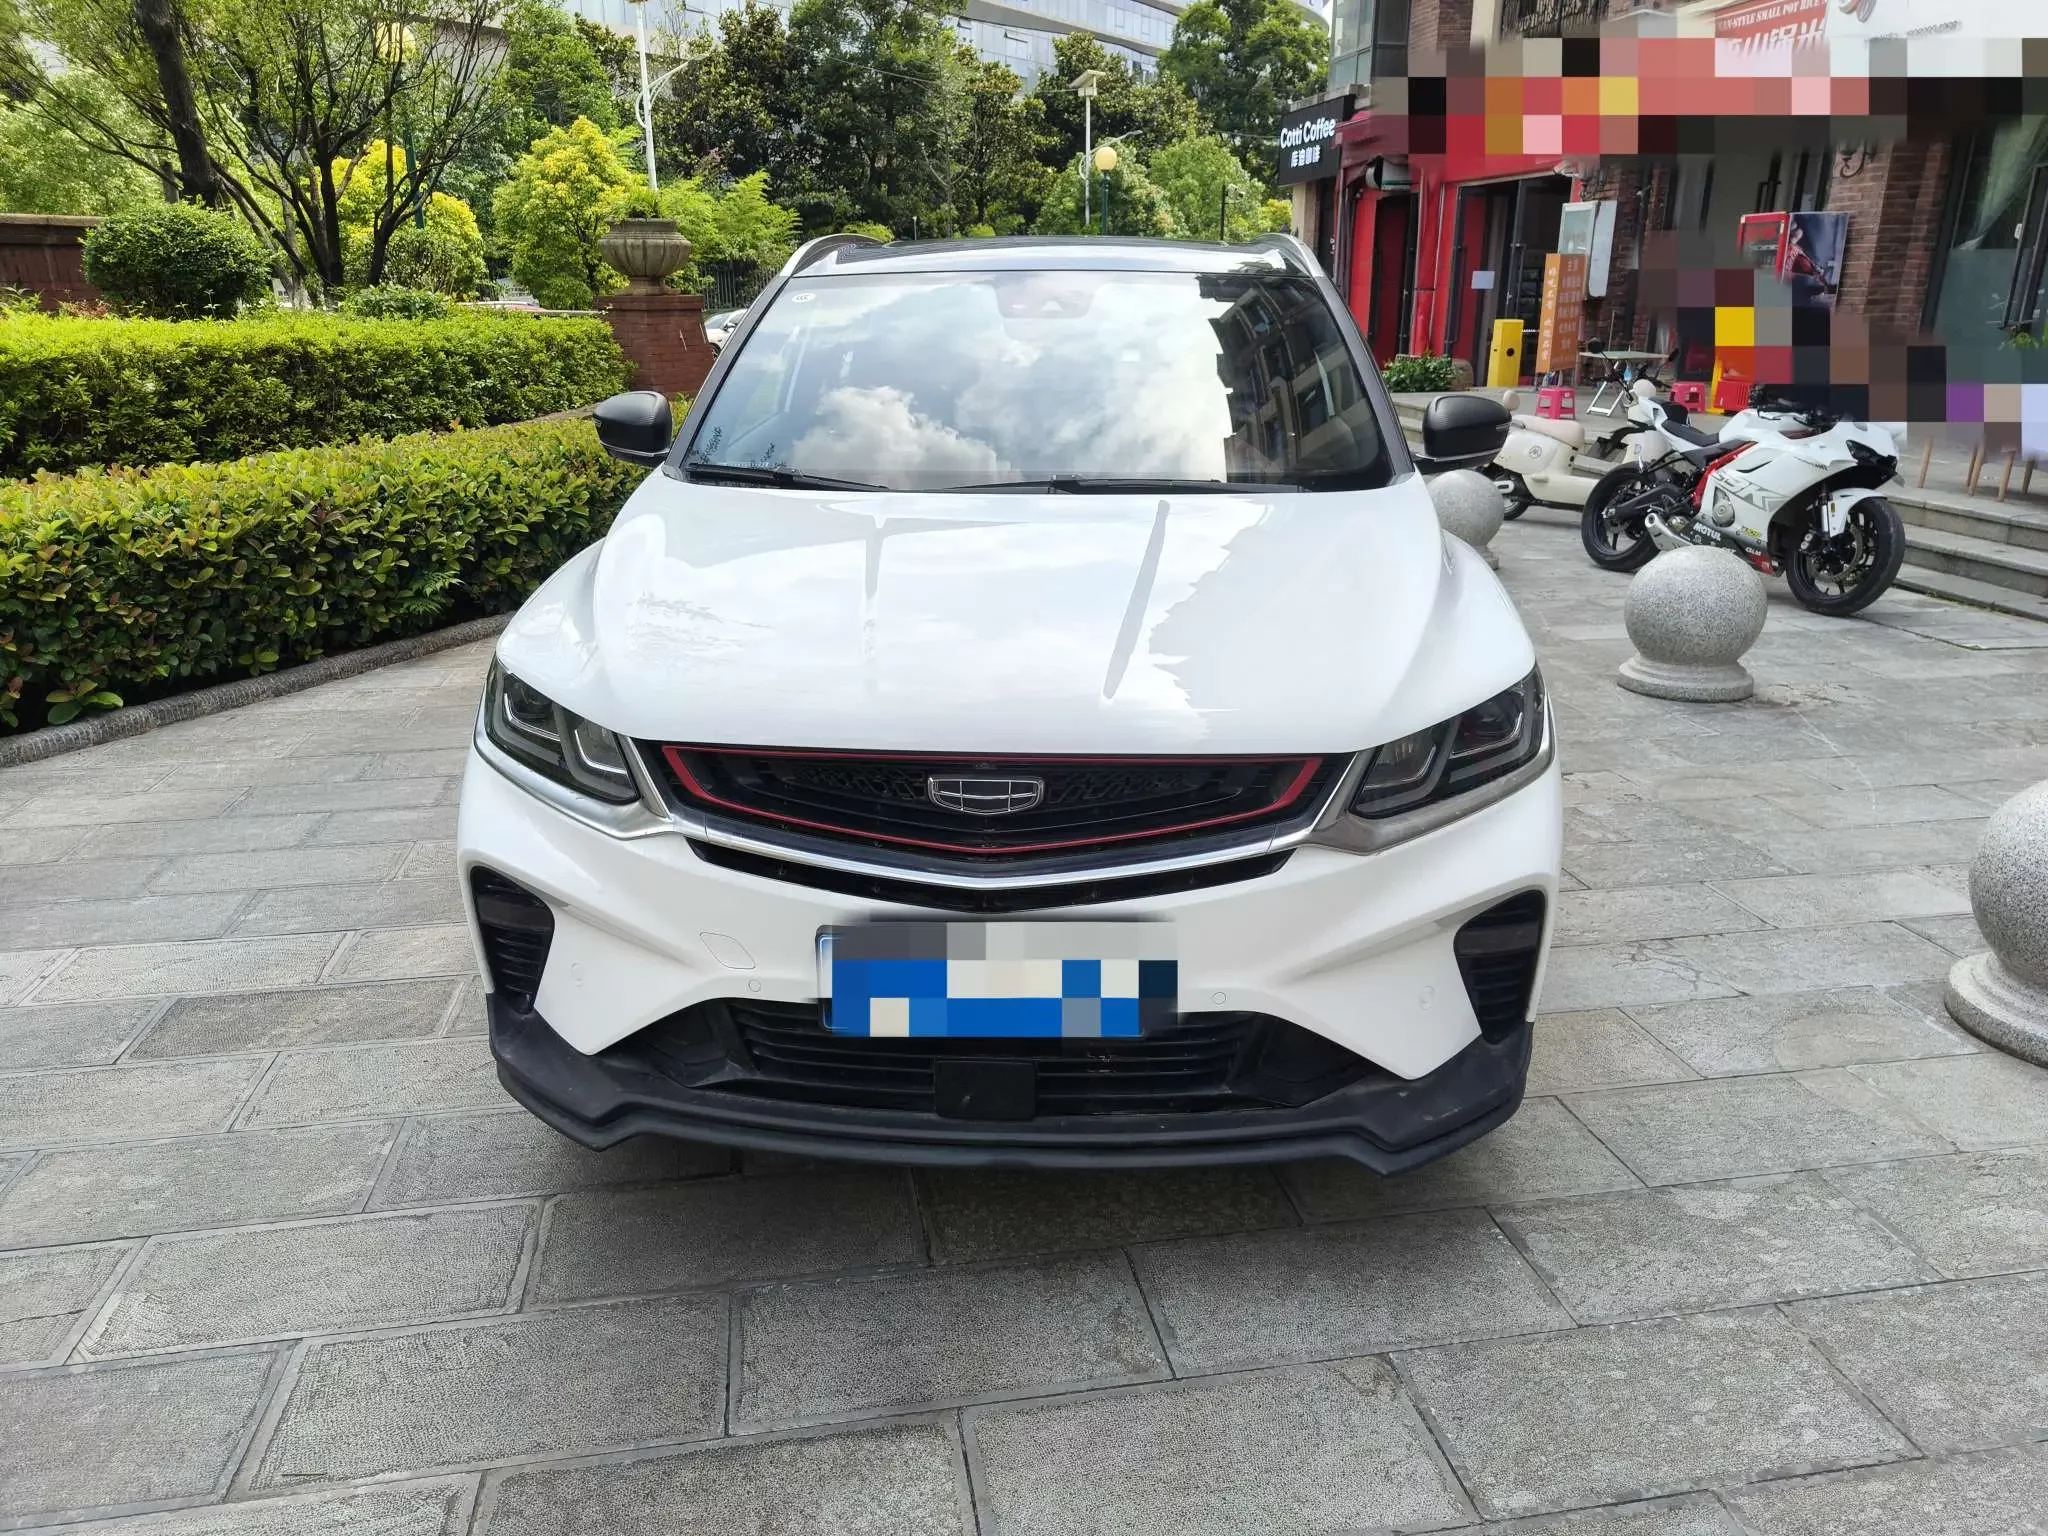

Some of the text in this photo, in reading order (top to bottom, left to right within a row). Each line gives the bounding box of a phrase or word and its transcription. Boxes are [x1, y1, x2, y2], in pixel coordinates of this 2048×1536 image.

[1756, 6, 1781, 22] SMALL
[1782, 2, 1800, 16] POT
[1280, 117, 1336, 149] Cotti Coffee
[1693, 522, 1721, 541] MOTUL
